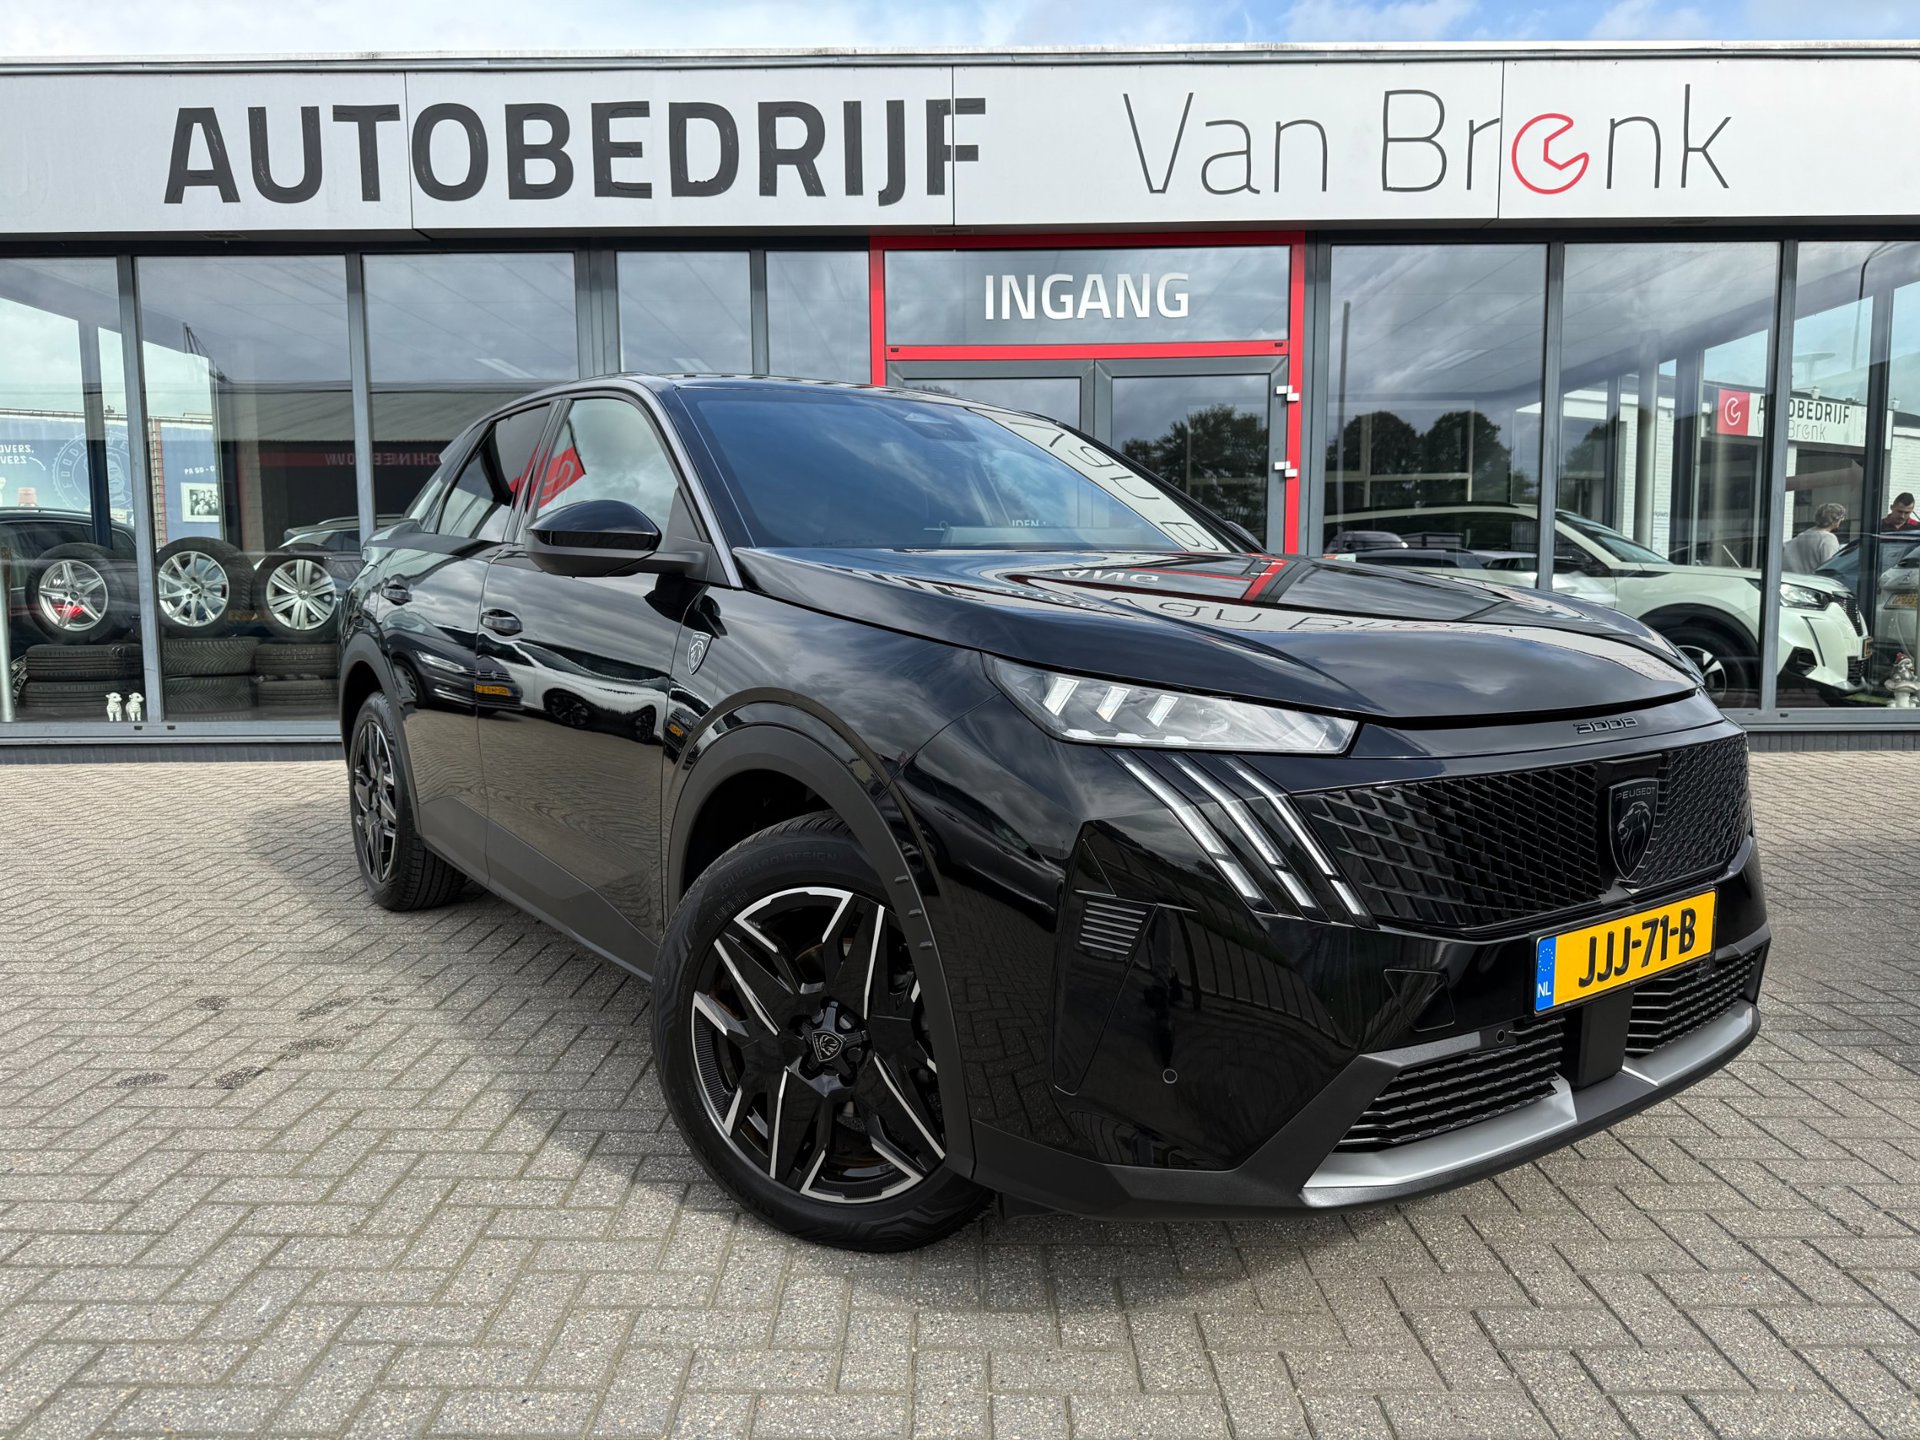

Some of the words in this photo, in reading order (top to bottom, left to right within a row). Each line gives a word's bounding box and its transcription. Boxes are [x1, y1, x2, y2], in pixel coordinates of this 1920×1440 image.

[165, 97, 986, 207] AUTOBEDRIJF
[1123, 92, 1329, 195] Van
[985, 271, 1190, 322] INGANG
[1573, 717, 1639, 734] 3008
[1616, 786, 1656, 800] PEUGEOT
[1578, 907, 1697, 988] JJJ-71-B
[1536, 979, 1552, 999] NL
